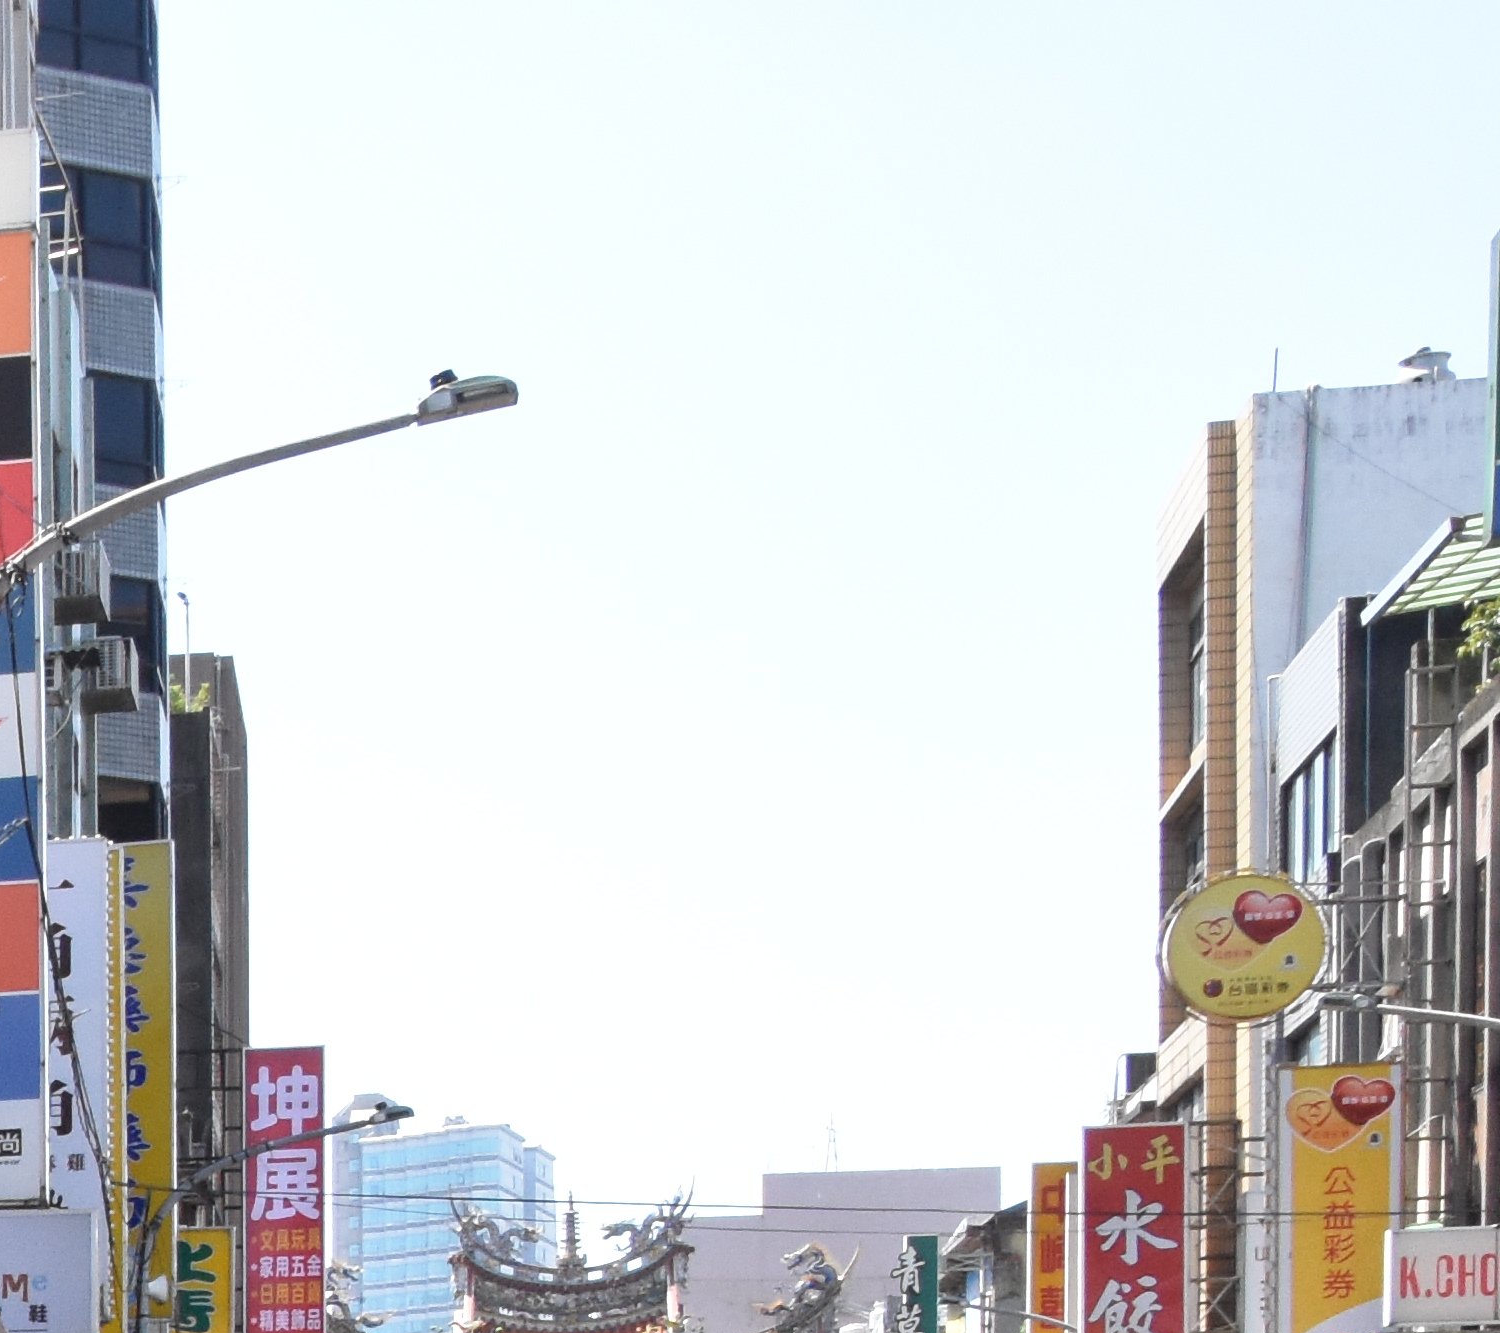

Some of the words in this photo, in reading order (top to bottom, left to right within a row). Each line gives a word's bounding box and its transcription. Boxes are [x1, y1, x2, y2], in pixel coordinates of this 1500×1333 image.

[250, 1064, 322, 1222] 坤展
[1088, 1135, 1183, 1186] 小平
[259, 1254, 321, 1278] 家用五金
[1323, 1166, 1356, 1299] 公益彩券
